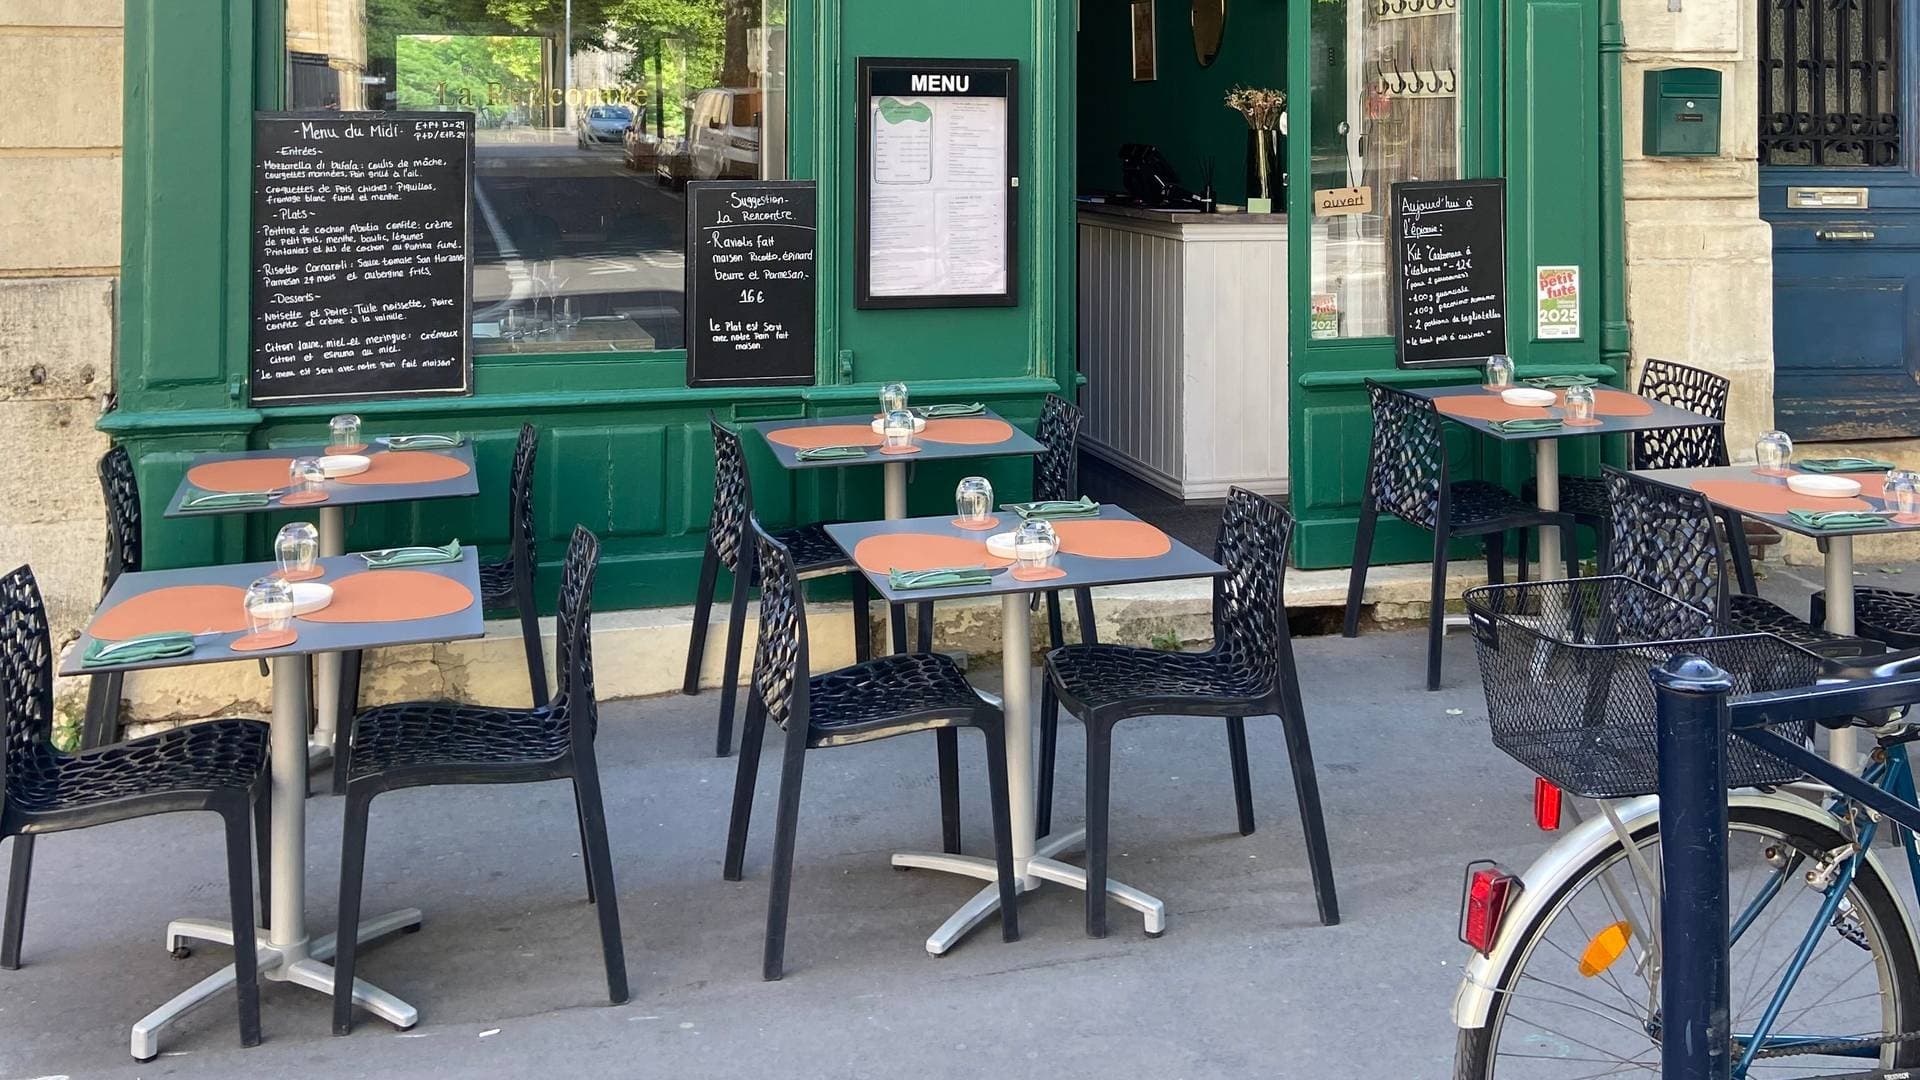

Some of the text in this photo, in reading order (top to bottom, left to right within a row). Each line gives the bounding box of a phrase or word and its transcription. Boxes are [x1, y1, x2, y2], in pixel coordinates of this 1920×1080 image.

[911, 75, 970, 92] MENU
[437, 81, 474, 105] La
[345, 123, 365, 138] du
[263, 160, 312, 170] Mozzarella
[316, 160, 325, 170] di
[368, 158, 394, 170] coulis
[397, 159, 409, 168] de
[319, 184, 331, 194] de
[266, 195, 301, 205] fromage
[304, 194, 326, 203] blanc
[332, 193, 355, 202] fumé
[359, 193, 368, 202] et
[1323, 195, 1364, 209] ouvert
[1402, 195, 1474, 221] Aujourd'hui à
[716, 210, 733, 224] La
[263, 225, 297, 236] Poitrine
[299, 225, 310, 235] de
[314, 226, 345, 234] cochon
[425, 220, 453, 230] crème
[265, 237, 276, 246] de
[392, 232, 424, 242] légumes
[757, 234, 775, 248] fait
[313, 245, 322, 254] et
[341, 243, 351, 253] de
[356, 244, 385, 253] cochon
[1407, 243, 1422, 261] Kit
[712, 253, 743, 264] maison
[782, 249, 813, 261] épinard
[263, 263, 299, 276] Risotto
[381, 257, 413, 266] tomate
[416, 254, 431, 264] San
[263, 276, 300, 288] Parmesan
[316, 273, 337, 283] mois
[346, 271, 358, 281] et
[365, 268, 405, 280] aubergine
[714, 268, 745, 280] beurre
[748, 269, 760, 280] et
[1539, 271, 1574, 291] petit
[1413, 293, 1433, 303] 100g
[1546, 283, 1576, 299] futé
[265, 310, 303, 322] Noisette
[310, 309, 321, 319] et
[354, 302, 378, 315] Tuile
[1414, 306, 1434, 315] 100g
[1540, 308, 1577, 322] 2025
[266, 320, 299, 331] confite
[305, 317, 315, 327] et
[319, 316, 345, 326] crème
[709, 317, 721, 332] Le
[746, 321, 758, 331] est
[1311, 320, 1337, 331] 2025
[1415, 319, 1421, 330] 2
[1452, 315, 1460, 323] de
[265, 341, 294, 353] Citron
[326, 337, 346, 348] miel
[420, 329, 458, 340] crémeux
[712, 334, 729, 342] avec
[730, 332, 751, 342] notre
[775, 331, 789, 340] fait
[1420, 336, 1433, 344] tout
[304, 353, 314, 362] et
[361, 348, 374, 356] au
[275, 370, 296, 379] menu
[299, 367, 311, 376] est
[338, 364, 355, 372] avec
[357, 361, 377, 371] notre
[401, 358, 418, 369] fait
